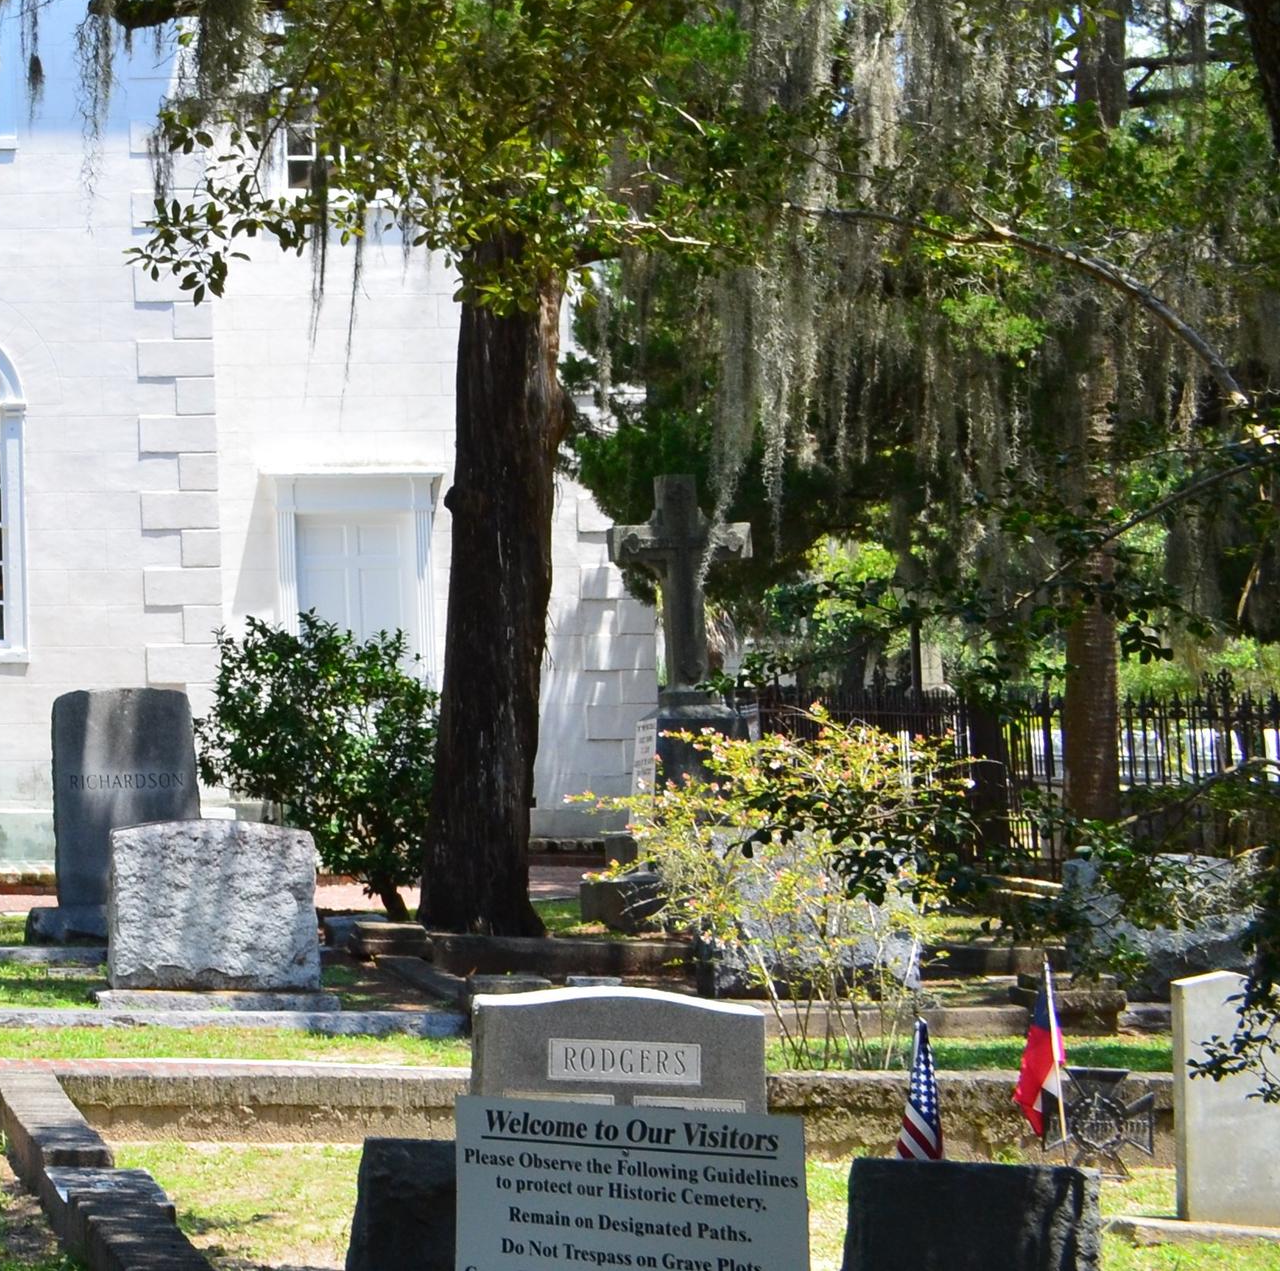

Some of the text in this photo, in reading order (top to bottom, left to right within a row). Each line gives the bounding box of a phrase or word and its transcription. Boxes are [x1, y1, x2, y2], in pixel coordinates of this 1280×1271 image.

[70, 773, 183, 789] RICHARDSON
[563, 1046, 688, 1076] RODGERS
[485, 1109, 780, 1152] Welcome to Our Visitors
[464, 1148, 799, 1189] Please Observe the Following Guidelines
[496, 1174, 768, 1212] to protect our Historic Cemetery.
[509, 1206, 752, 1243] Remain on Designated Paths.
[501, 1238, 525, 1256] Do
[528, 1240, 559, 1259] Not
[562, 1243, 632, 1267] Trespass
[636, 1254, 657, 1269] on
[661, 1251, 713, 1271] Grave
